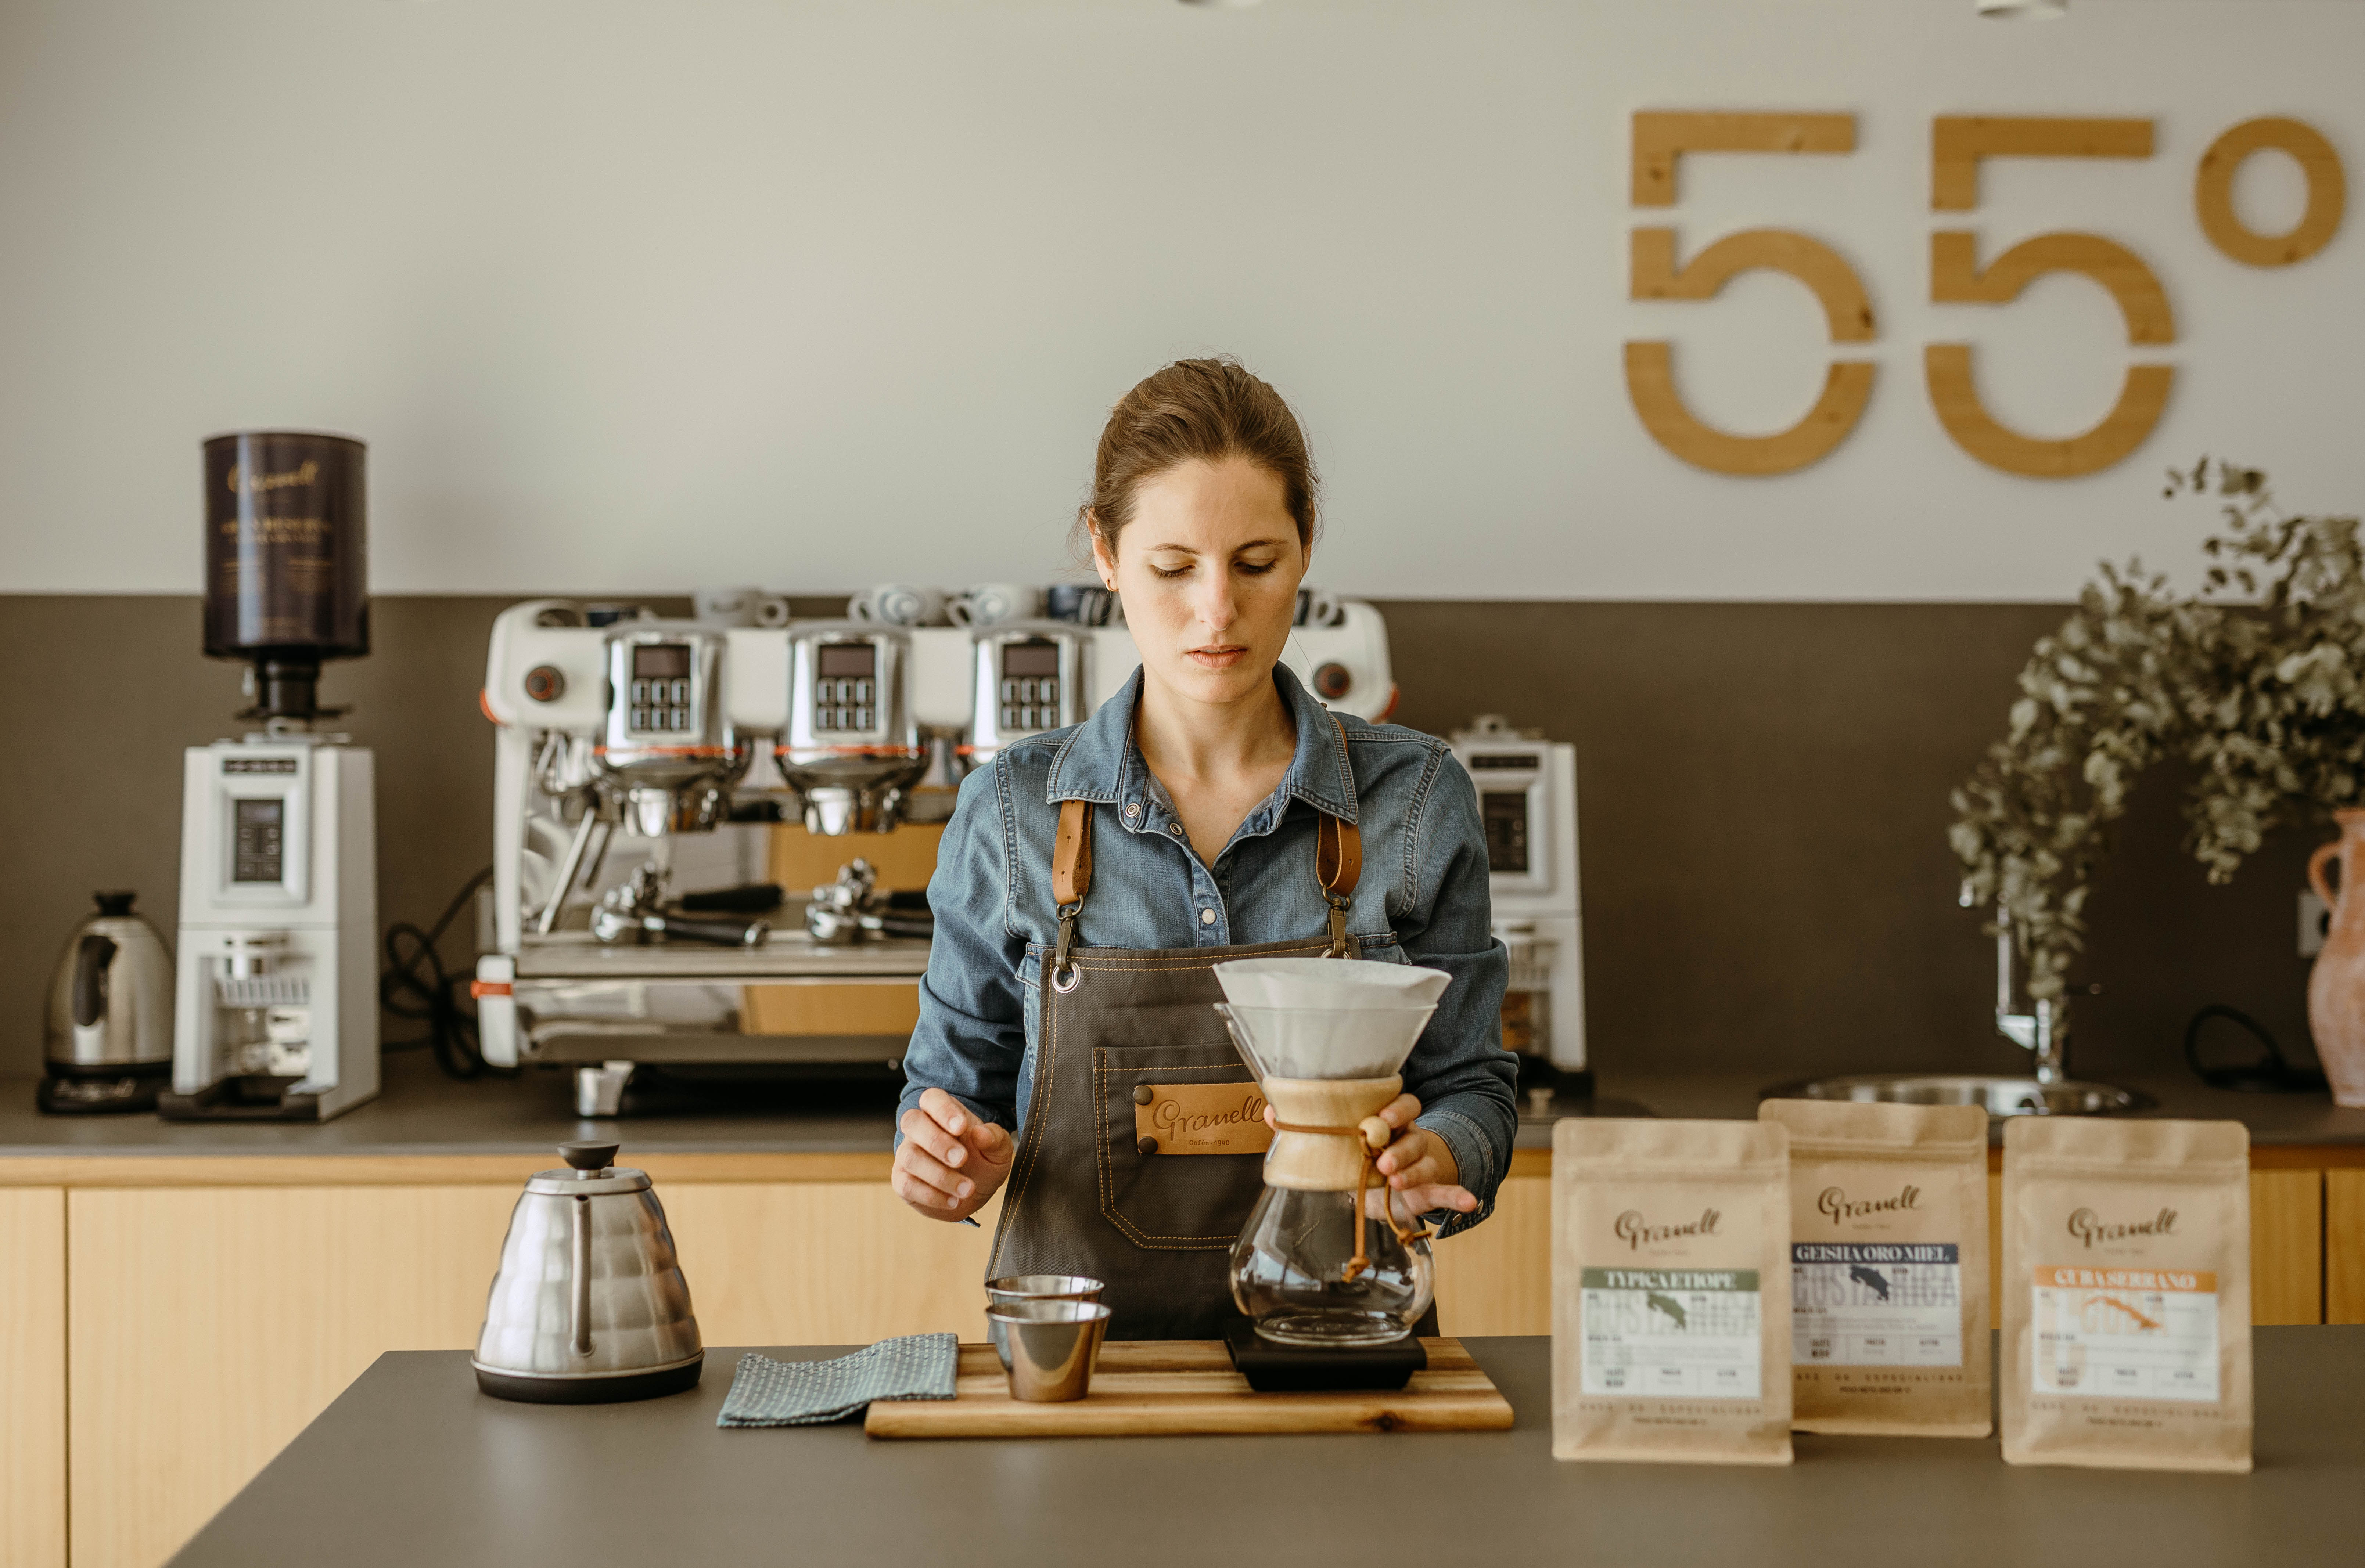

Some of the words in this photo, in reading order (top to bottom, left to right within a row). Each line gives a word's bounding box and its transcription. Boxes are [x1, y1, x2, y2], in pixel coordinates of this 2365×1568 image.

[1153, 1095, 1265, 1141] Granell
[1818, 1185, 1922, 1225] Granell
[1614, 1208, 1722, 1249] Granell
[2067, 1207, 2178, 1247] Granell
[1796, 1246, 1862, 1262] GEISHA
[1863, 1246, 1902, 1262] ORO
